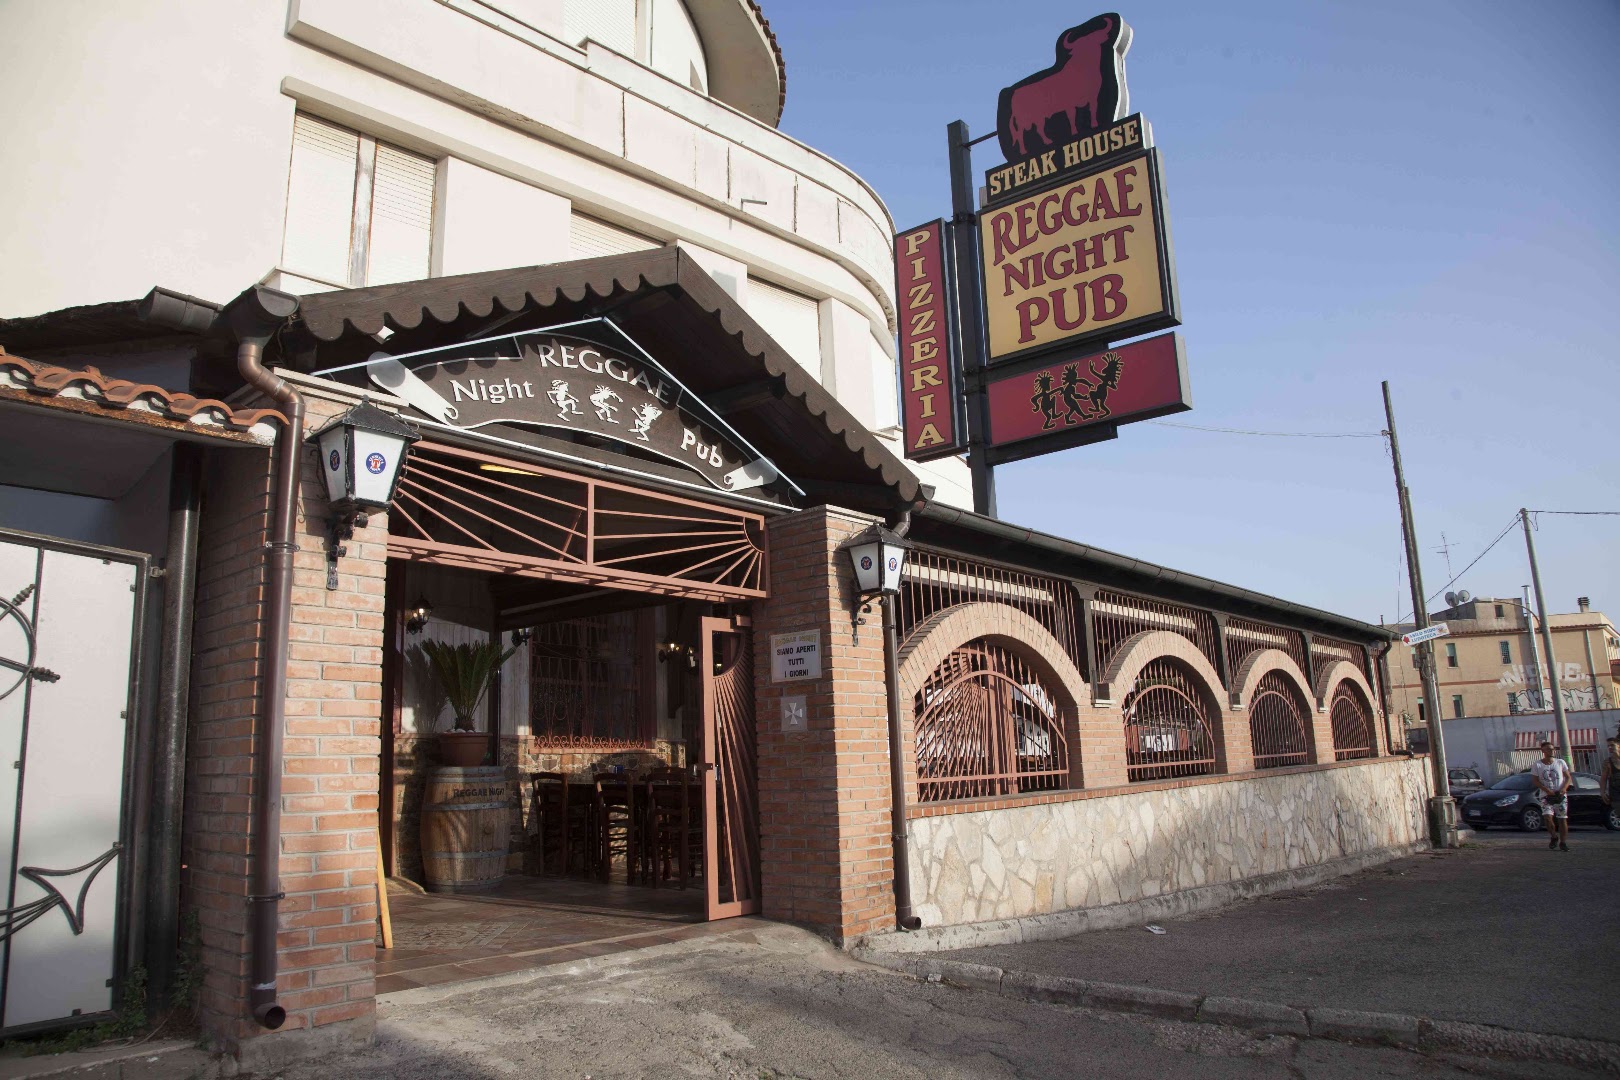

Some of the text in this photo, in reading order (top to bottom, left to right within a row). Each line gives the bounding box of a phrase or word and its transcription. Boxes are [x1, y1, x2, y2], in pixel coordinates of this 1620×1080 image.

[989, 121, 1139, 196] STEAK HOUSE
[990, 165, 1143, 266] REGGAE
[1001, 224, 1135, 296] NIGHT
[1015, 273, 1129, 344] PUB
[904, 229, 945, 449] PIZZERIA
[449, 378, 535, 405] Night
[537, 343, 672, 405] REGGAE
[680, 428, 724, 469] Pub
[788, 657, 805, 666] TUTTI
[790, 668, 809, 678] GIORNI
[796, 644, 816, 654] APERTI
[454, 788, 488, 798] REGGAE
